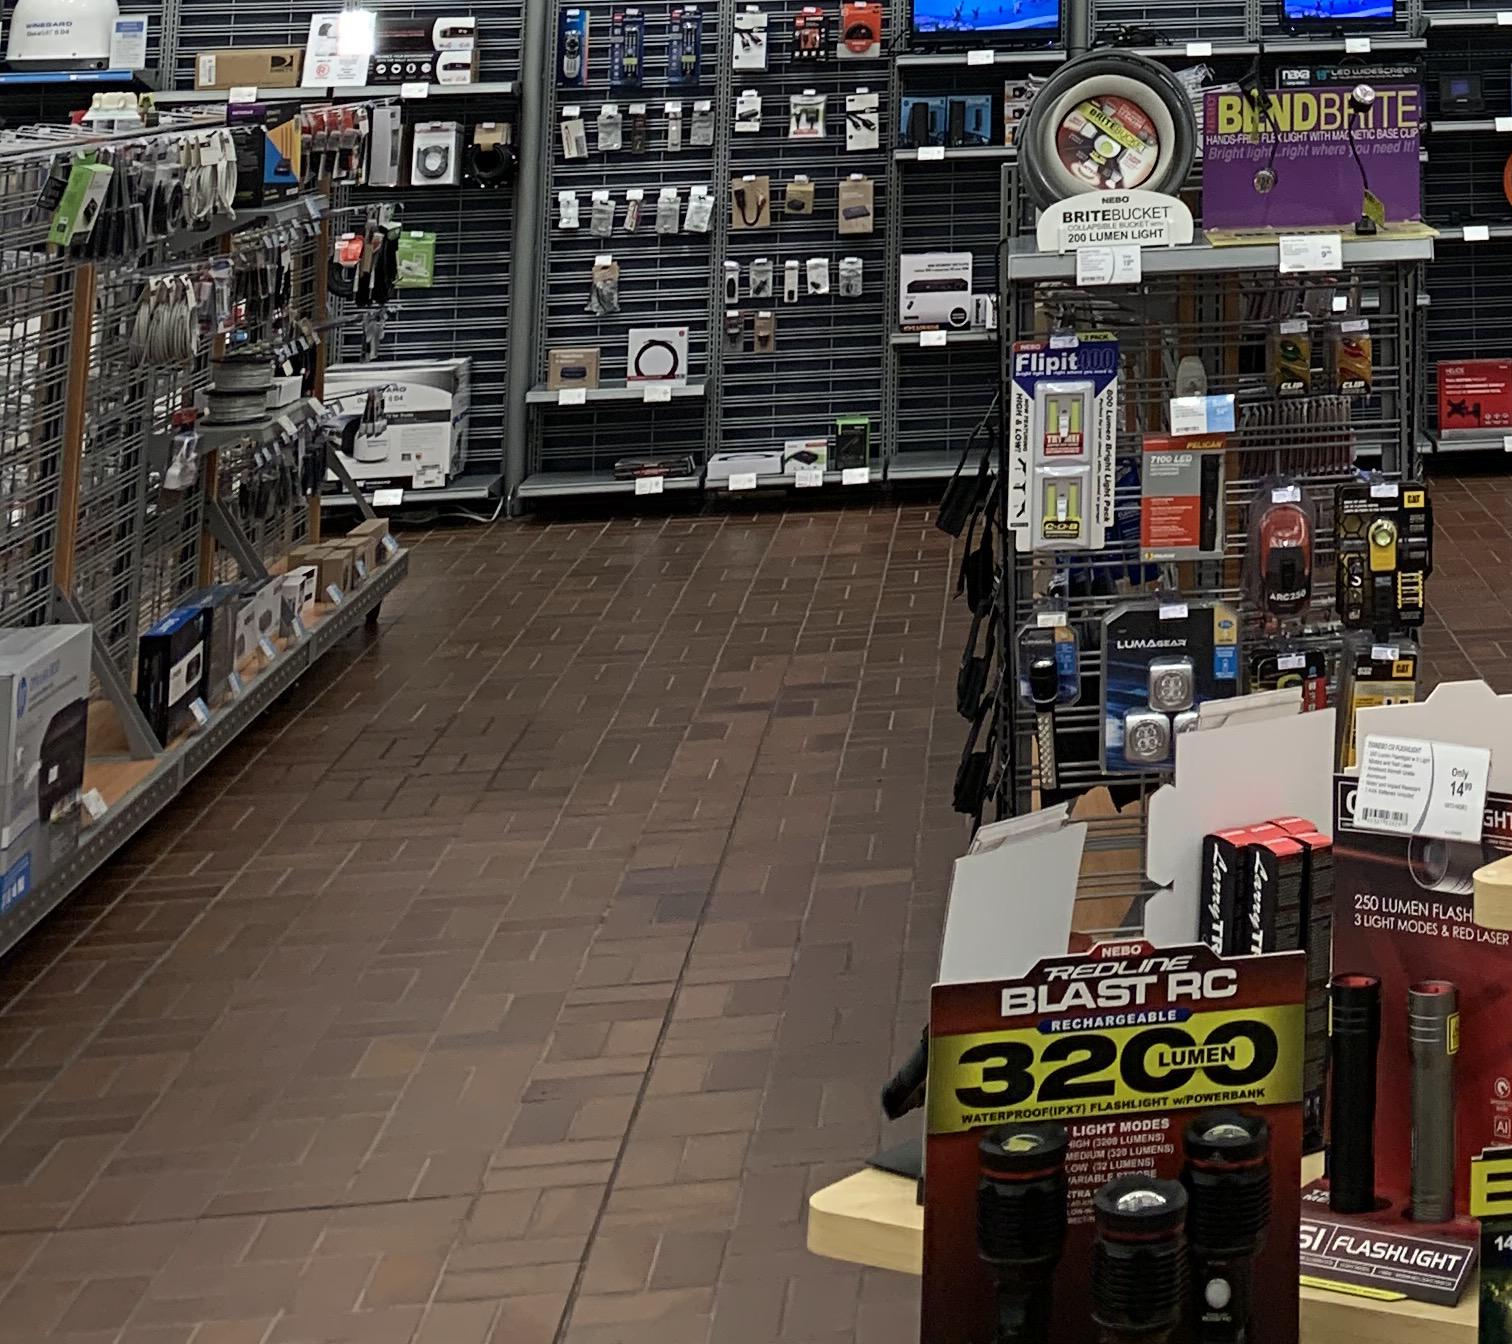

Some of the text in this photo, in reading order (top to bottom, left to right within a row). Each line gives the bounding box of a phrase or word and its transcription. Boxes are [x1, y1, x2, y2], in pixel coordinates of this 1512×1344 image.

[1284, 132, 1308, 143] LIGHT
[1309, 131, 1331, 142] WITH
[1376, 128, 1400, 140] BASE
[1400, 127, 1419, 139] CLIP
[1208, 140, 1401, 163] Bright where need
[1101, 196, 1130, 204] NEBO
[1062, 206, 1170, 224] BRITEBUCKET
[1068, 229, 1165, 243] 200 LUMEN LIGHT
[1015, 352, 1078, 376] Flipit
[1280, 381, 1304, 390] CLIP
[1342, 380, 1366, 390] CLIP
[1015, 393, 1023, 417] HIGH
[1105, 409, 1113, 441] Lumen
[1104, 443, 1112, 471] Bright
[1150, 454, 1193, 464] 7100 LED
[1103, 474, 1112, 497] Light
[1103, 500, 1111, 522] Pack
[1116, 638, 1188, 650] LUMAGEAR
[1451, 767, 1470, 780] Only
[1353, 894, 1474, 923] 250 LUMEN FLASH
[1354, 913, 1510, 946] 3 LIGHT MODES & RED LASER
[1101, 945, 1143, 959] NEBO
[1044, 954, 1196, 982] REDLINE
[1000, 967, 1238, 1017] BLAST RC
[1051, 1009, 1177, 1032] RECHARGEABLE
[955, 1020, 1279, 1109] 3200
[1158, 1045, 1237, 1069] LUMEN
[961, 1087, 1266, 1125] WATERPROOF(IPX7) FLASHLIGHT w/POWERBANK
[1072, 1117, 1171, 1138] LIGHT MODES
[1120, 1132, 1166, 1145] LUMENS)
[1065, 1149, 1106, 1162] MEDIUM
[1129, 1143, 1175, 1157] LUMENS)
[1109, 1157, 1155, 1171] LUMENS)
[1332, 1235, 1463, 1273] FLASHLIGHT
